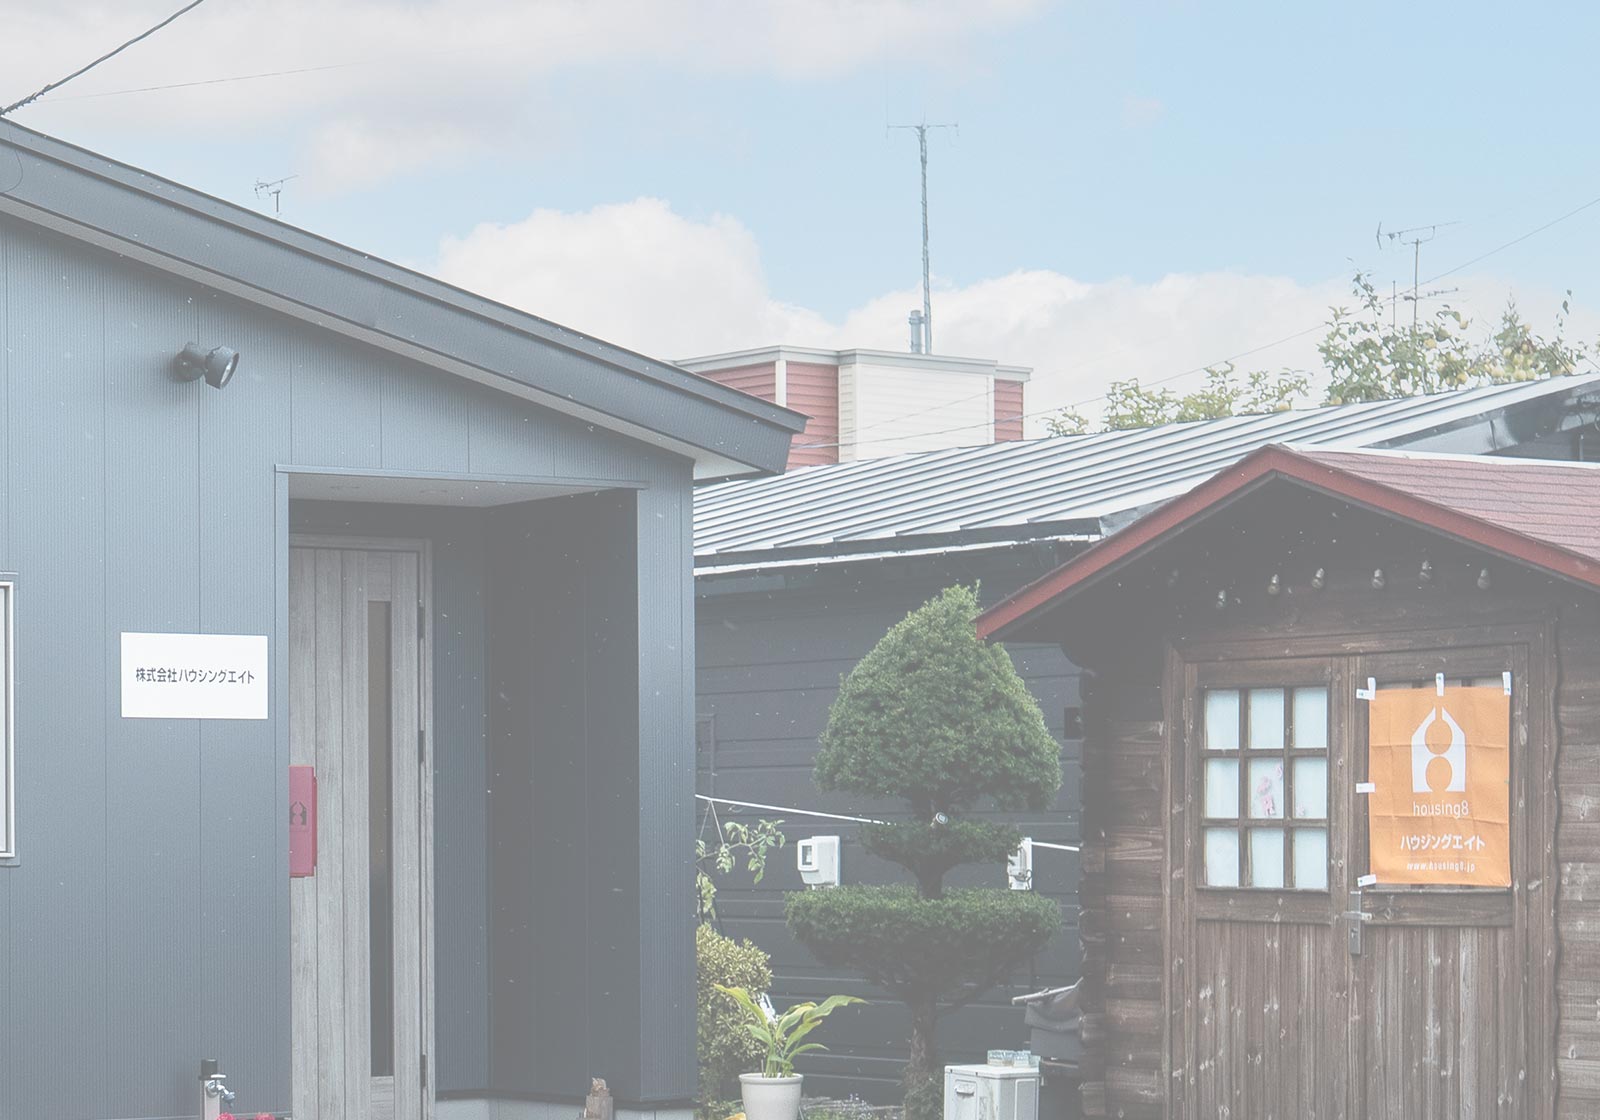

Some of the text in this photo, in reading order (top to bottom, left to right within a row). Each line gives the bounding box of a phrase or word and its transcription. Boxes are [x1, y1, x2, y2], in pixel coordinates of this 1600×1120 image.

[1413, 800, 1469, 820] housing8
[1400, 833, 1486, 851] ハウジングエイト
